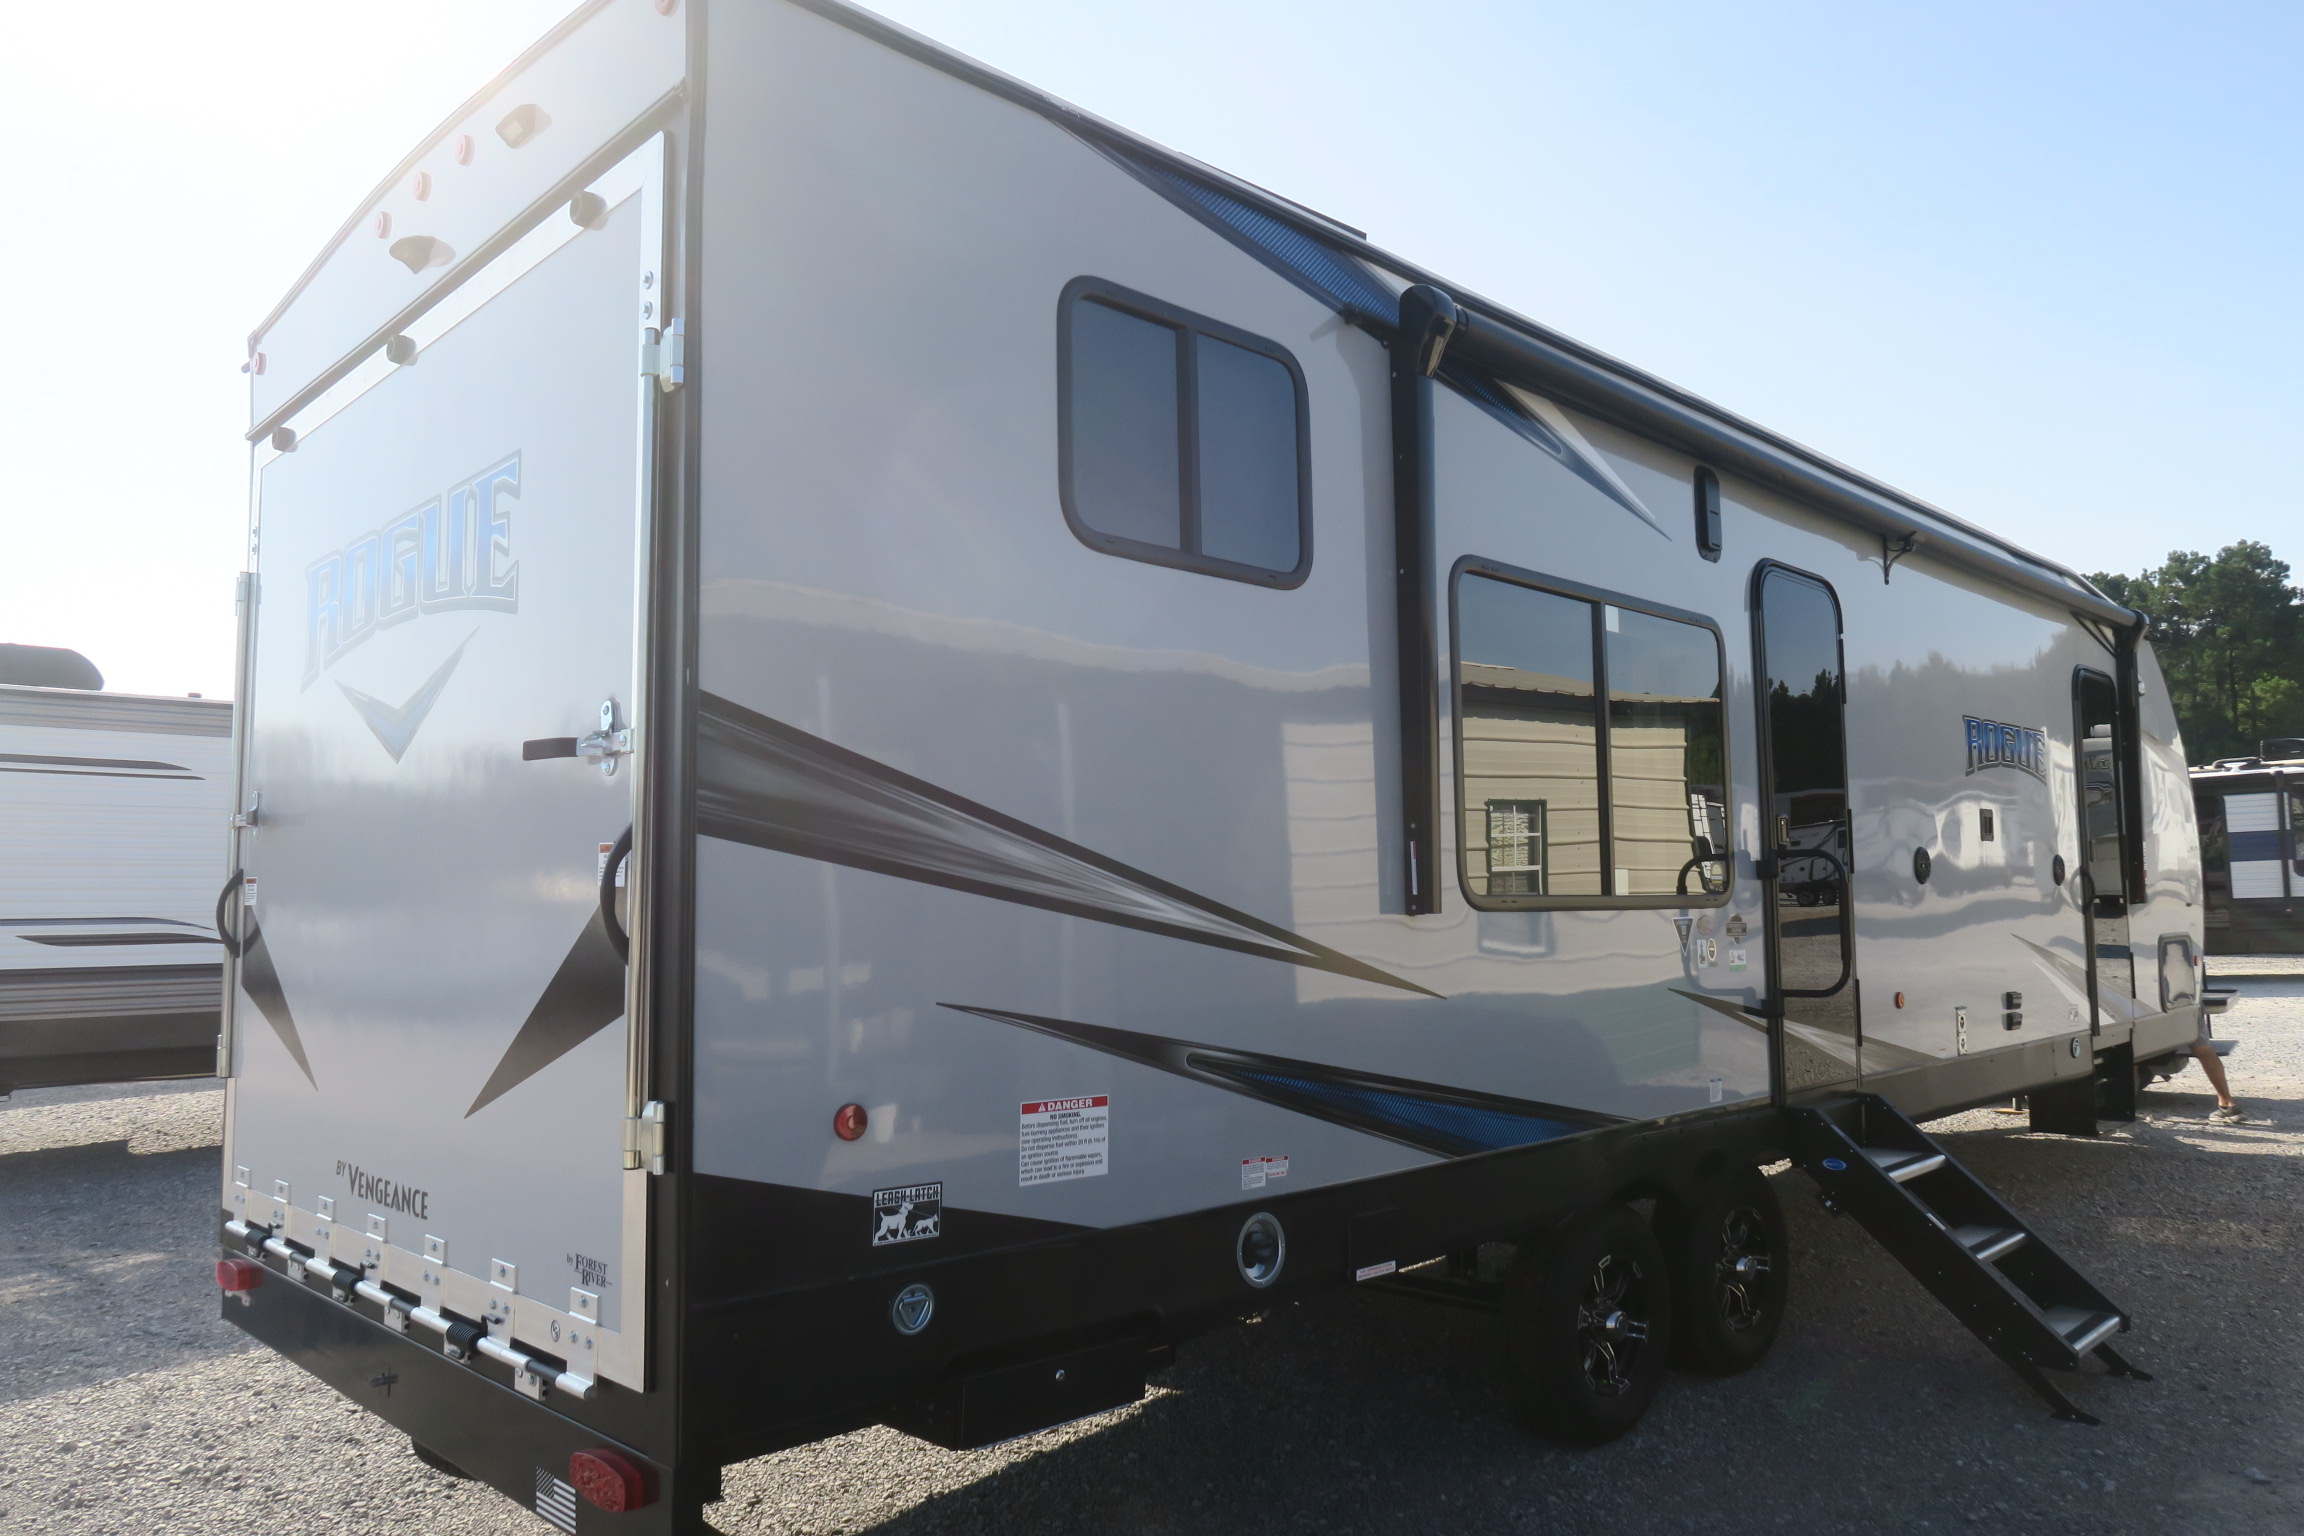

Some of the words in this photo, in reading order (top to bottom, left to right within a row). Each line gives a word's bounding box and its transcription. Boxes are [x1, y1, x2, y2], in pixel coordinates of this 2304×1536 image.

[300, 448, 522, 694] ROGUE
[1962, 715, 2047, 785] ROGUE
[1047, 1098, 1093, 1111] DANGER
[1036, 1119, 1059, 1128] dispensing
[1021, 1128, 1047, 1138] fuel-burning
[1048, 1126, 1070, 1135] appliances
[1090, 1122, 1104, 1130] igniters
[1031, 1136, 1050, 1144] operating
[1035, 1142, 1054, 1151] dispense
[1027, 1151, 1043, 1159] ignition
[1043, 1156, 1059, 1164] ignition
[1065, 1153, 1086, 1161] flammable
[1075, 1159, 1094, 1168] explosion
[1020, 1174, 1032, 1182] result
[336, 1160, 347, 1177] BY
[348, 1163, 429, 1221] VENGEANCE
[566, 1253, 574, 1266] by
[576, 1253, 608, 1276] FOREST
[581, 1268, 607, 1289] RIVER
